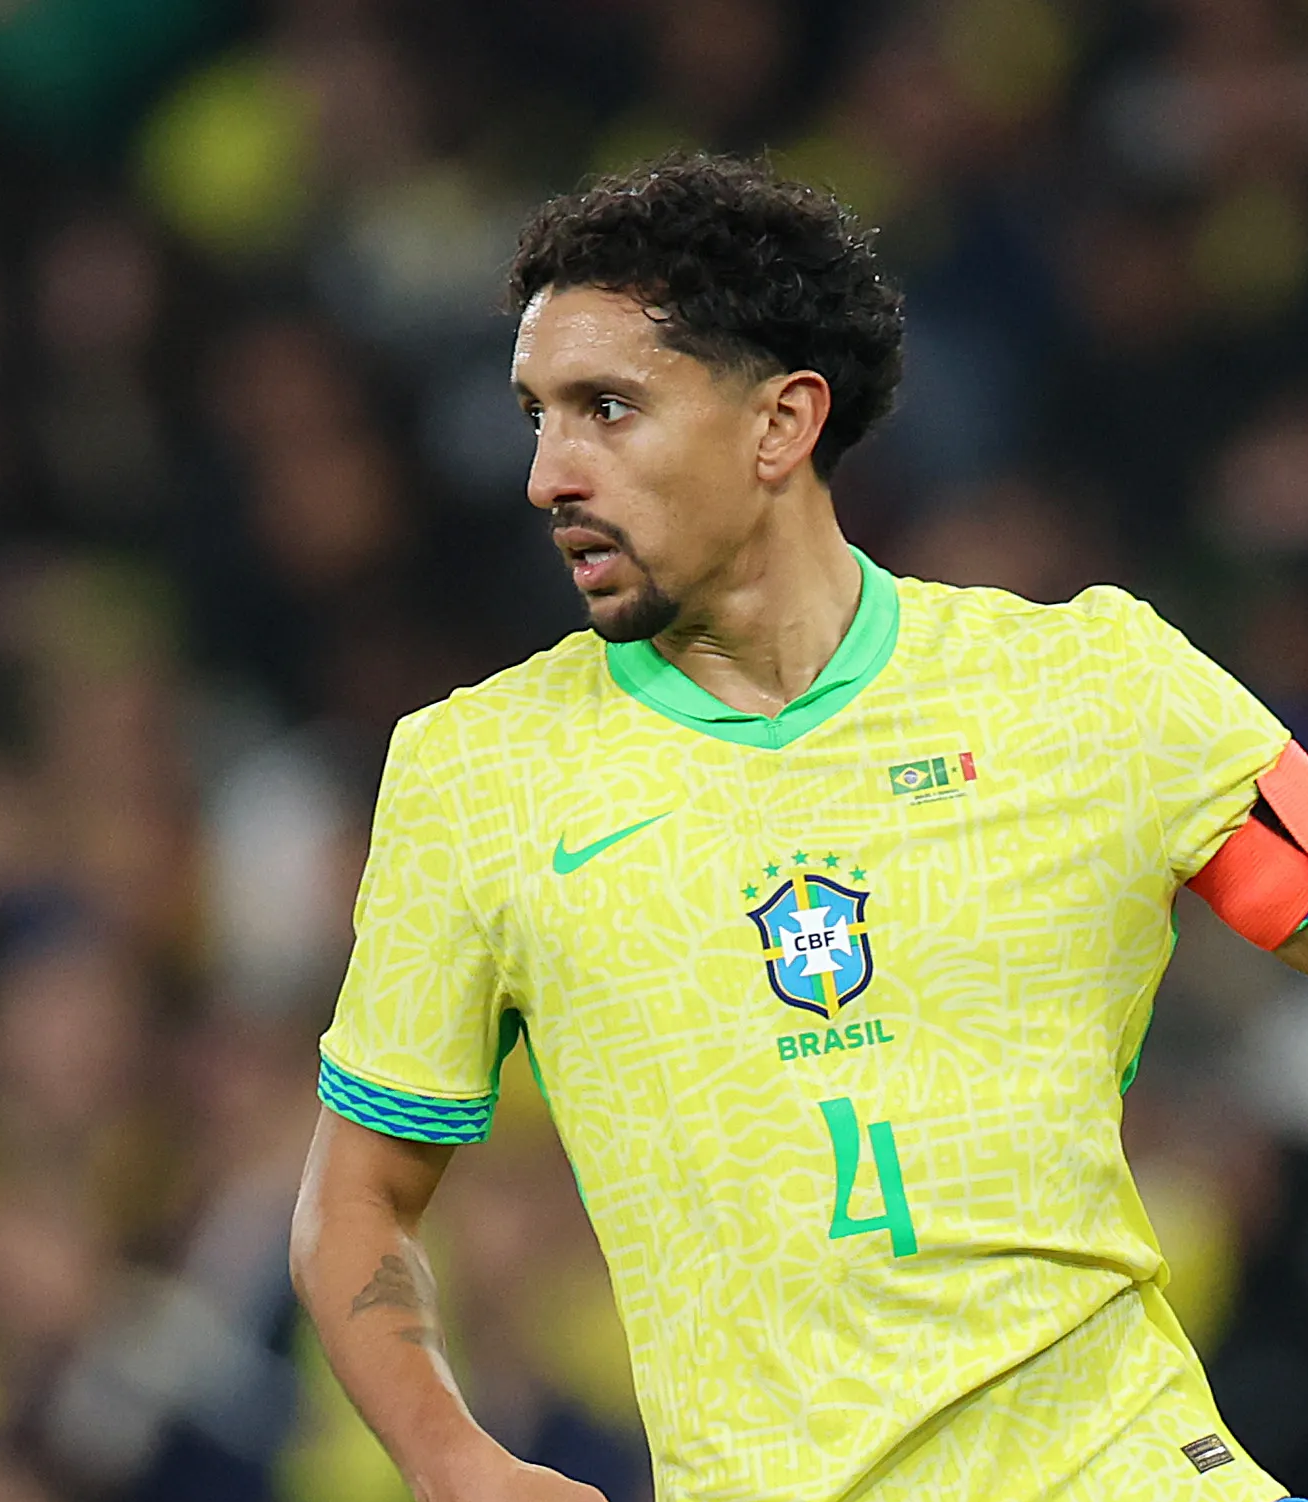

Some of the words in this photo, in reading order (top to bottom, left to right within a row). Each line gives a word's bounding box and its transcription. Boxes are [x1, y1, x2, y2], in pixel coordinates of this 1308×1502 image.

[793, 931, 836, 952] CBF
[776, 1019, 895, 1062] BRASIL
[818, 1097, 918, 1259] 4
